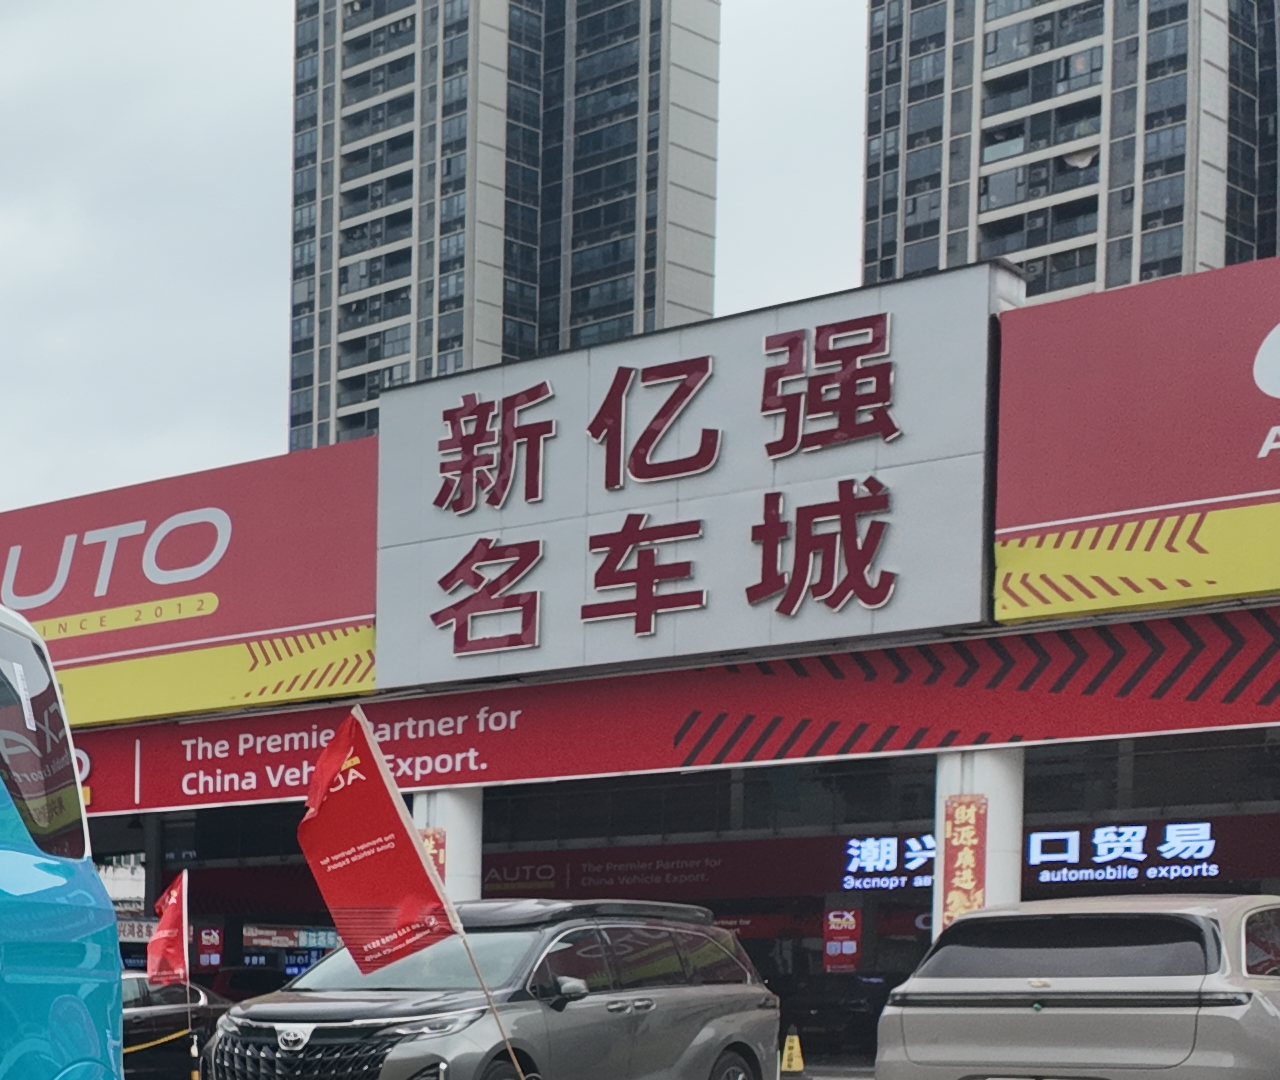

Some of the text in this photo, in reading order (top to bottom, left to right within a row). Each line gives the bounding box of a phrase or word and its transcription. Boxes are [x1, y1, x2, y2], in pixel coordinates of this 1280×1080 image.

[432, 312, 903, 516] 新亿强
[429, 475, 897, 657] 名车城
[42, 599, 206, 638] INCE 2012
[182, 736, 229, 762] The
[238, 725, 335, 756] Premie
[475, 706, 522, 732] for
[182, 767, 257, 795] China
[1028, 822, 1216, 864] 口贸易
[484, 864, 555, 883] AUTO
[843, 874, 907, 890] Экспорт
[1039, 861, 1219, 883] automobile exports
